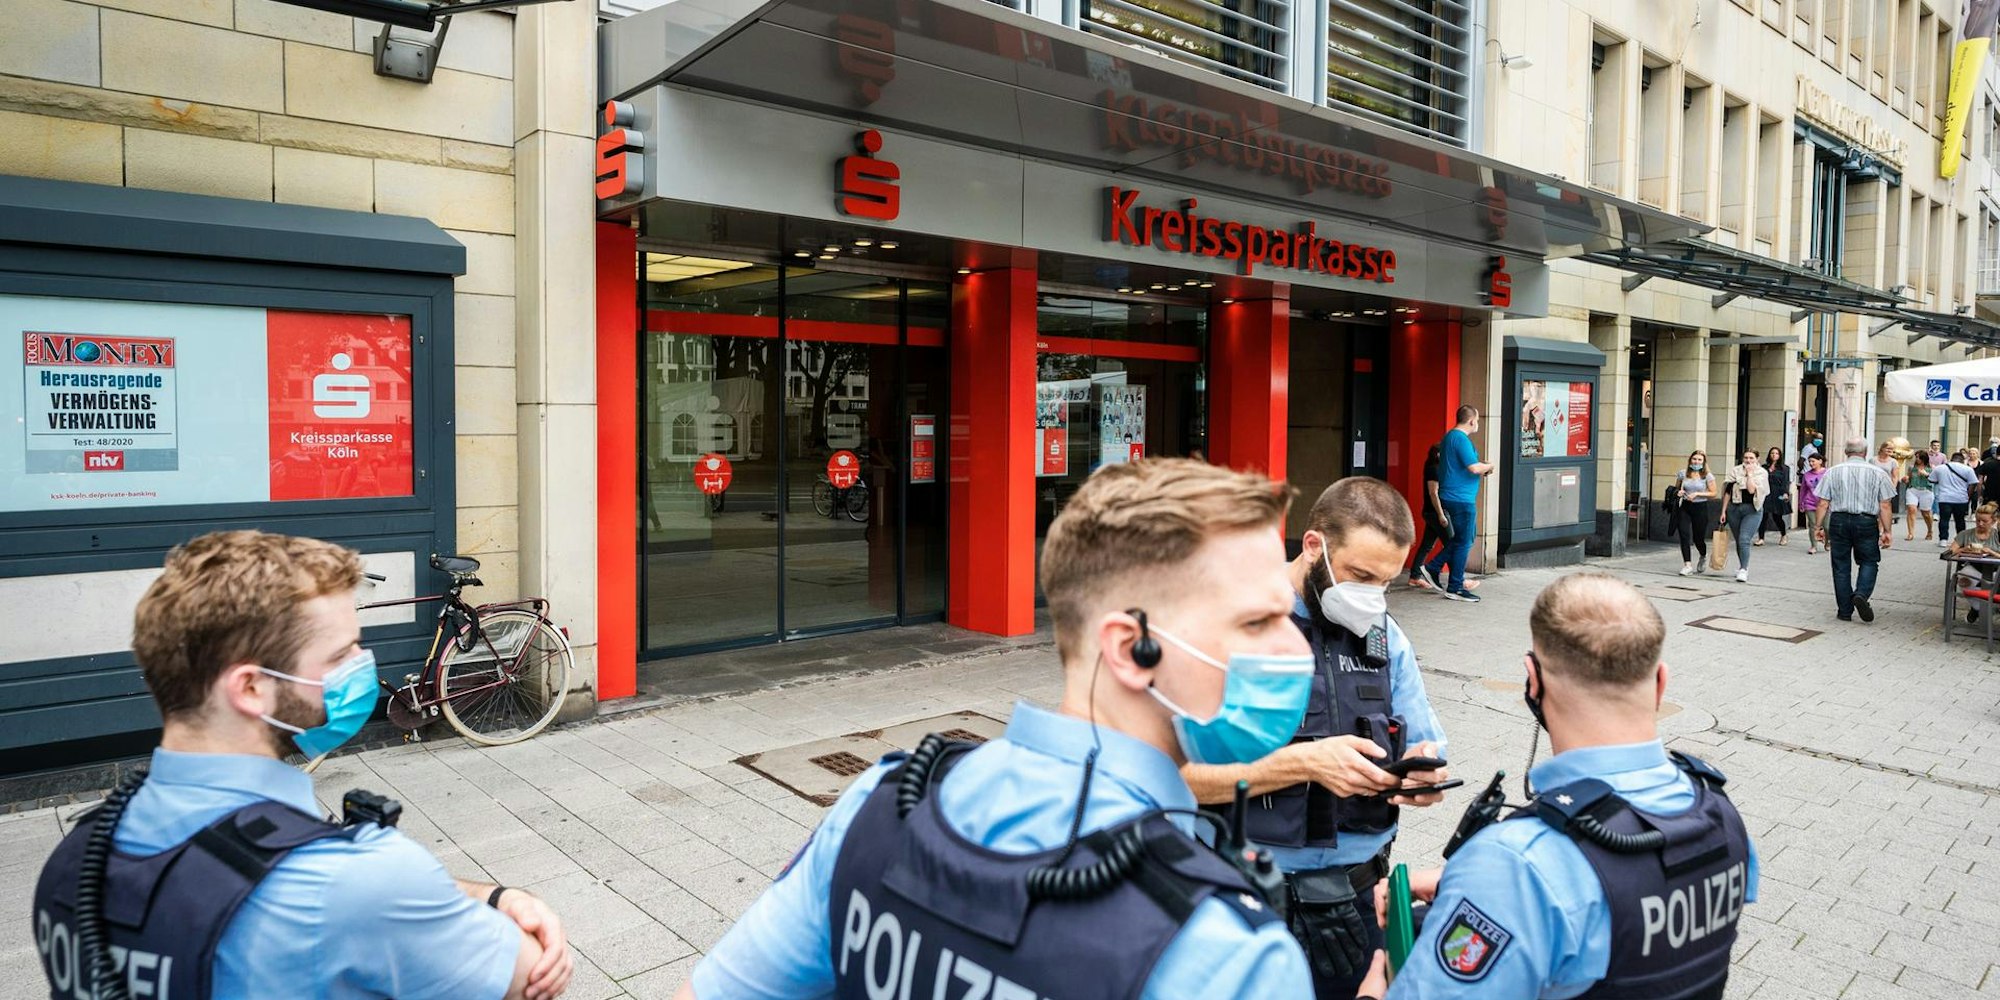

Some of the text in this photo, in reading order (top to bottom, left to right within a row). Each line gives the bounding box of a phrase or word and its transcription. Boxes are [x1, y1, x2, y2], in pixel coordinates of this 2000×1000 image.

[1106, 186, 1397, 283] Kreissparkasse
[27, 333, 38, 364] FOCUS
[40, 370, 162, 390] Herausragende
[50, 390, 157, 410] VERMÖGENS-
[48, 412, 156, 430] VERWALTUNG
[73, 438, 134, 446] Test: 48/2020
[290, 432, 393, 446] Kreissparkasse
[89, 453, 120, 467] ntv
[327, 446, 358, 459] Köln
[50, 491, 157, 500] ksk-koeln.de/private-banking
[1640, 861, 1746, 957] POLIZEI
[1460, 903, 1506, 946] POLIZEI
